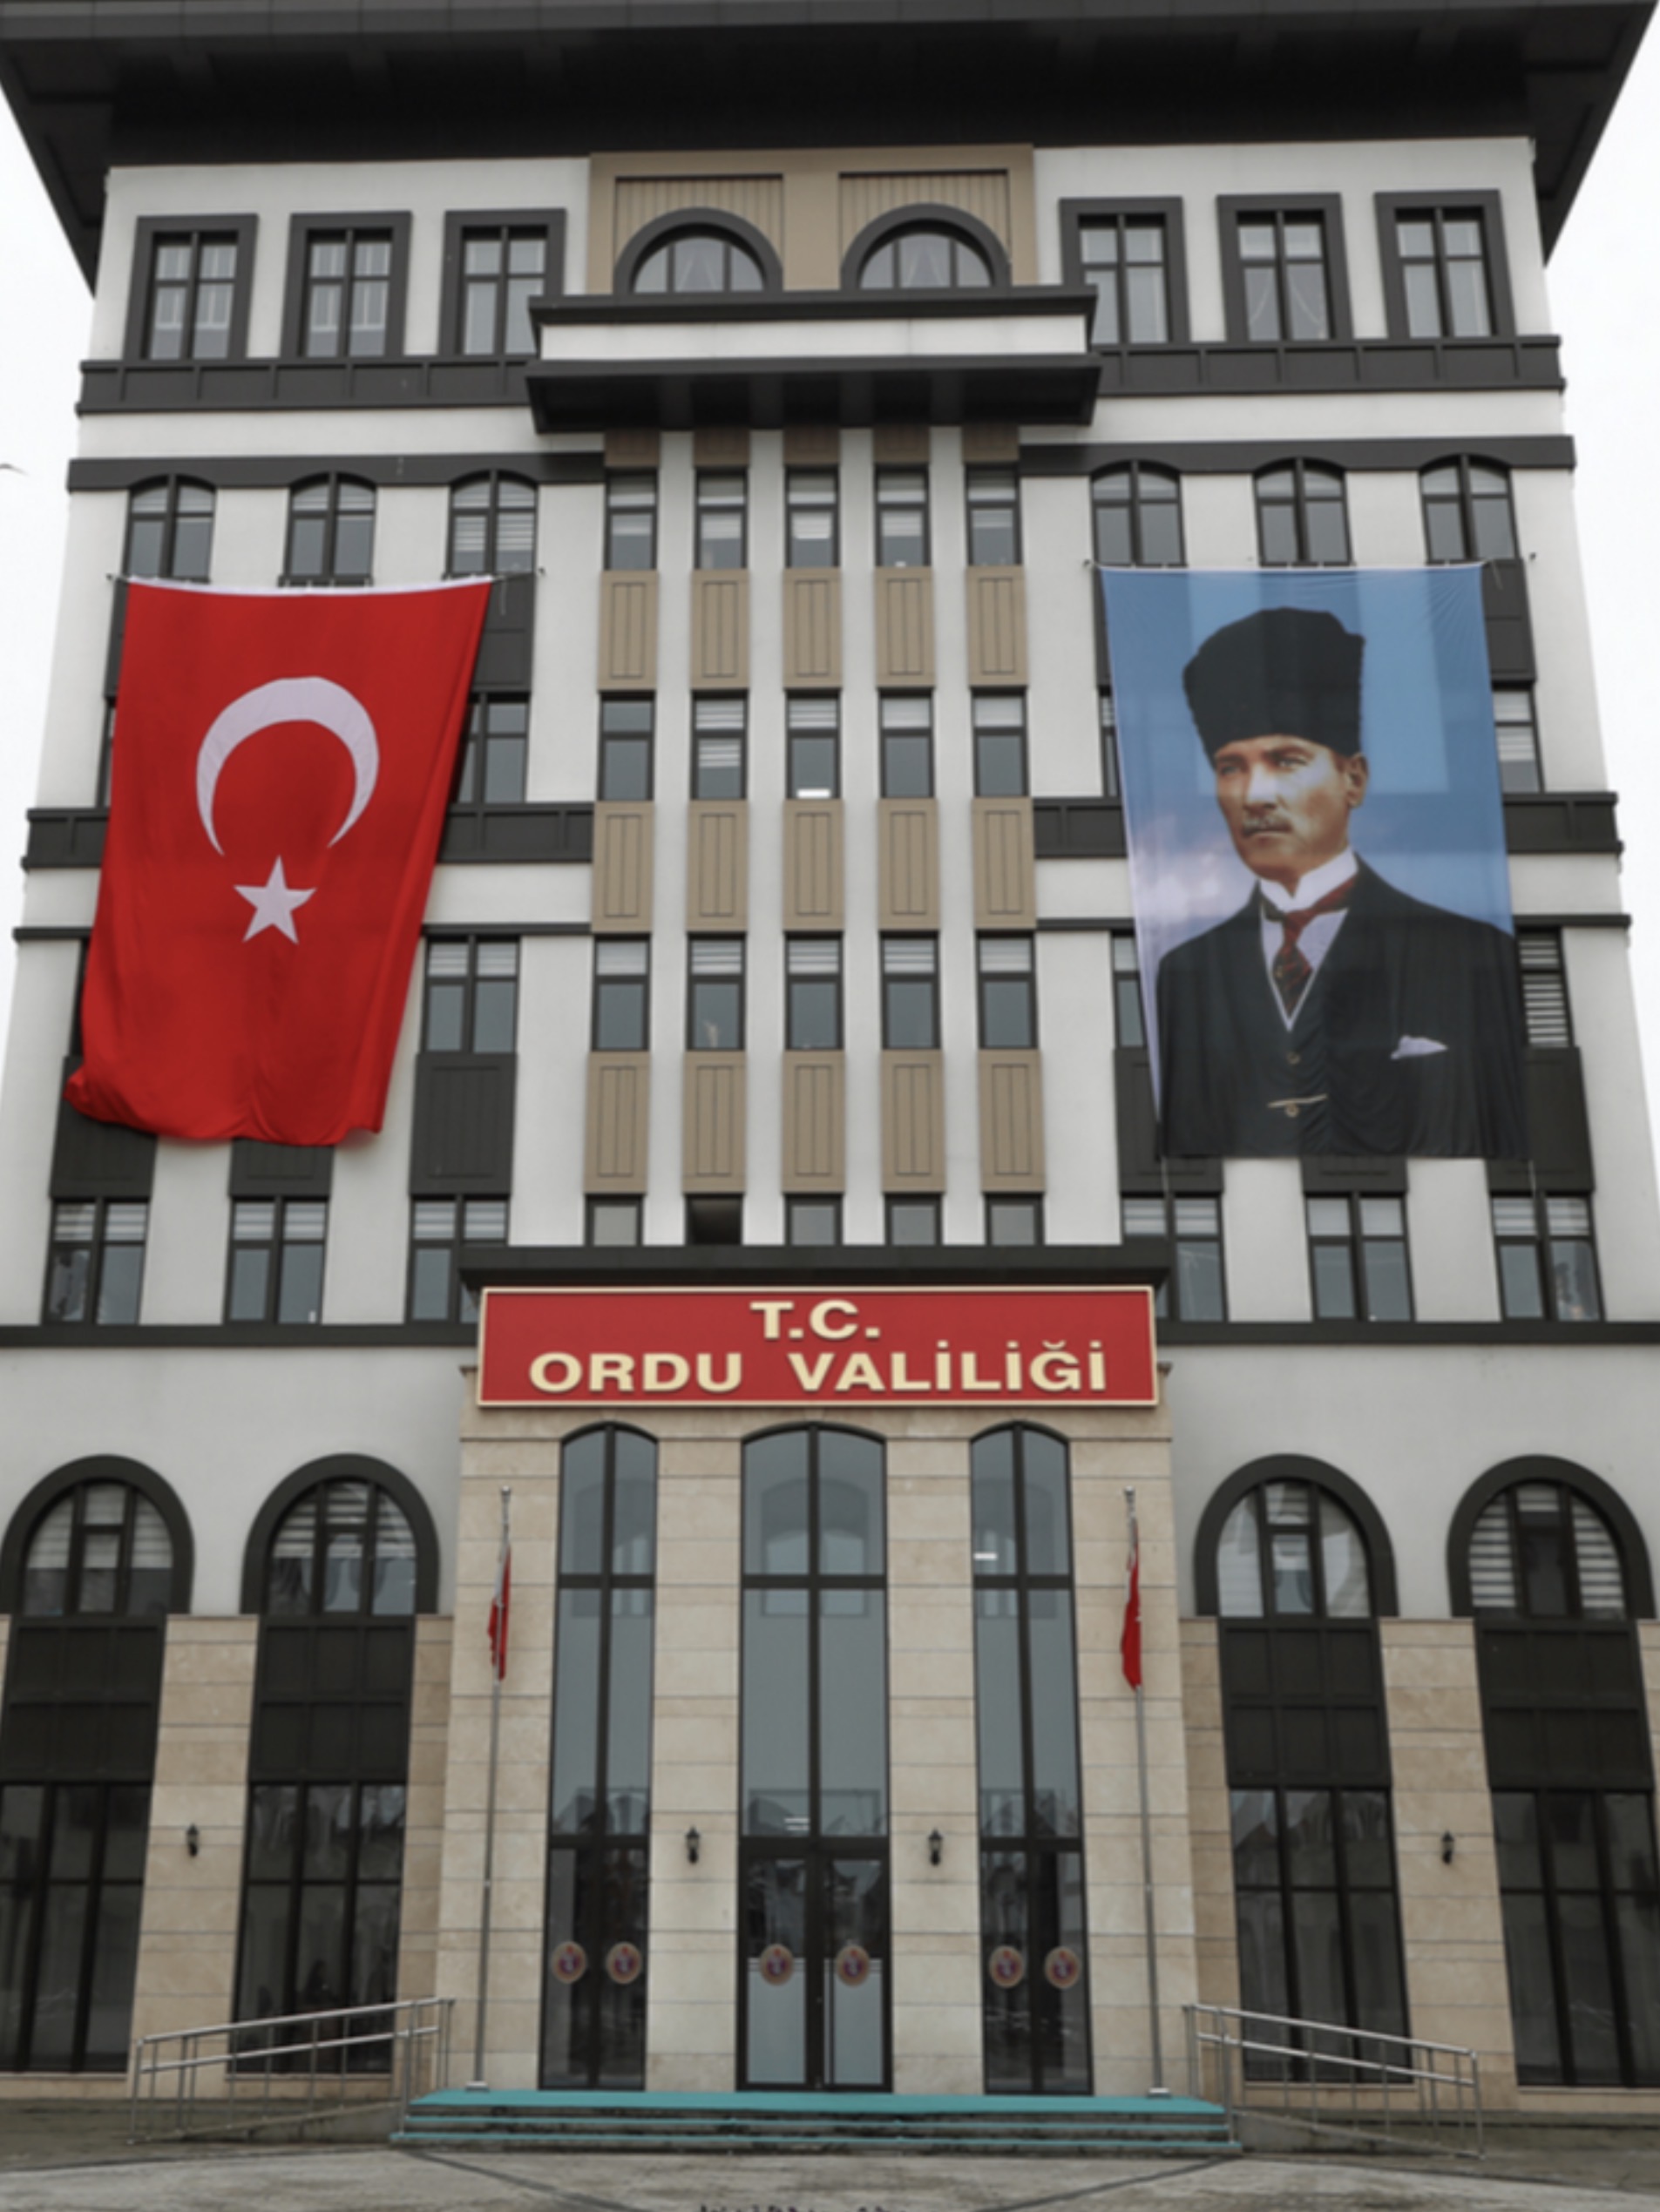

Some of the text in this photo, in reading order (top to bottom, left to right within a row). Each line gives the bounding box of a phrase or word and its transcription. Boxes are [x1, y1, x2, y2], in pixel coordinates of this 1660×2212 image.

[749, 1300, 880, 1339] T.C.
[529, 1340, 1106, 1392] ORDU VALİLİĞİ
